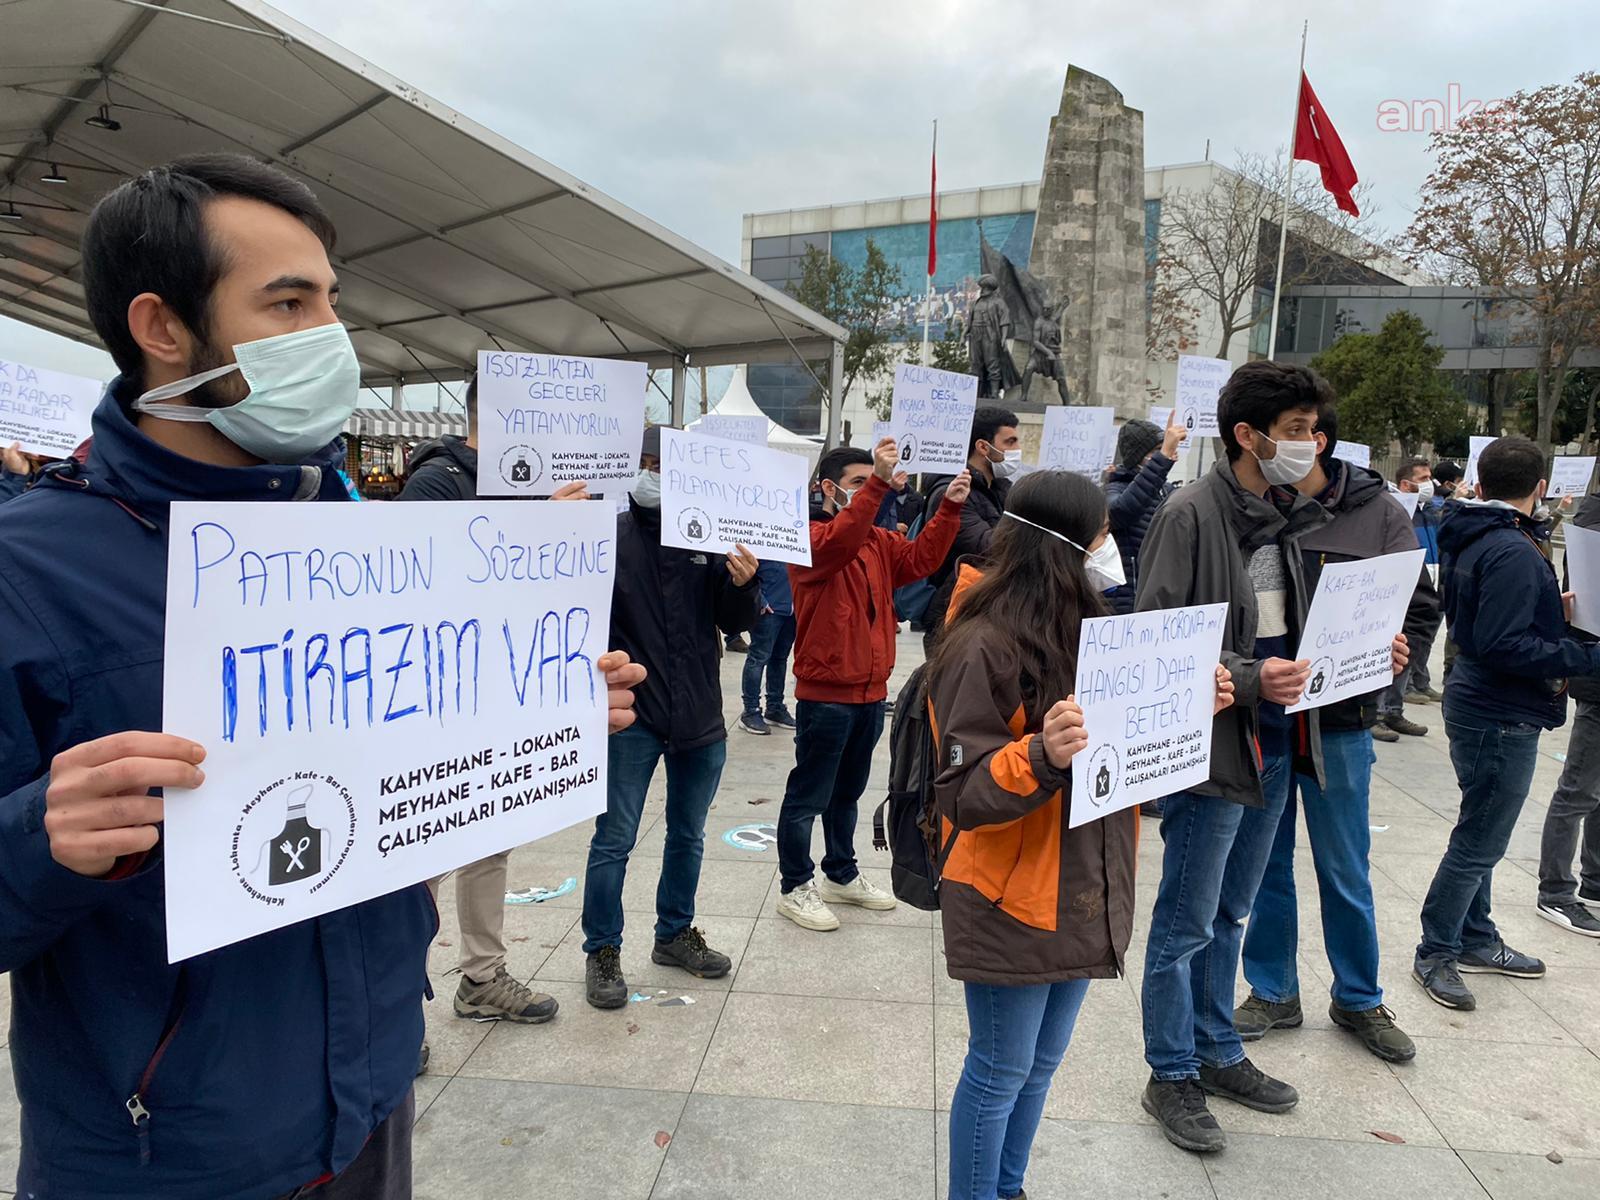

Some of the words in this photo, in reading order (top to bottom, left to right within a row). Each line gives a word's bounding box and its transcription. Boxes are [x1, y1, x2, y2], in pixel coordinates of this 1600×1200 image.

[16, 364, 39, 384] DA
[17, 385, 76, 412] KADAR
[529, 382, 607, 402] GECELERİ
[496, 408, 621, 437] YATAMIYORUM
[552, 452, 598, 460] KAHVEHANE
[604, 452, 630, 460] LOKANTA
[617, 461, 629, 469] BAR
[669, 438, 751, 473] NEFES
[552, 473, 598, 482] ÇALIŞANLARI
[599, 471, 635, 480] DAYANIŞMASI
[718, 517, 763, 529] KAHVEHANE
[770, 524, 798, 536] LOKANTA
[718, 526, 754, 537] MEYHANE
[761, 531, 779, 540] KAFE
[785, 535, 798, 543] BAR
[718, 535, 764, 547] ÇALIŞANLARI
[766, 541, 807, 554] DAYANIŞMASI
[192, 522, 433, 608] PATRONUN
[467, 516, 610, 584] SÖZLERİNE
[1083, 619, 1134, 657] AÇLIK
[1162, 610, 1206, 642] KORONA
[502, 607, 596, 708] VAR
[1080, 659, 1146, 706] HANGİSİ
[1154, 655, 1196, 692] DAHA
[1125, 688, 1193, 739] BETER?
[1125, 756, 1161, 772] MEYHANE
[1167, 748, 1184, 761] KAFE
[1190, 743, 1201, 754] BAR
[1126, 738, 1171, 758] KAHVEHANE
[1177, 729, 1203, 745] LOKANTA
[379, 748, 493, 796] KAHVEHANE
[513, 725, 581, 758] LOKANTA
[1124, 769, 1170, 789] ÇALIŞANLARI
[1170, 753, 1208, 774] DAYANIŞMASI
[379, 782, 470, 825] MEYHANE
[490, 764, 532, 790] KAFE
[550, 750, 578, 772] BAR
[230, 824, 242, 871] Lokanta
[242, 778, 284, 815] Meyhane
[294, 770, 318, 780] Kafe
[325, 775, 341, 789] Bar
[377, 800, 495, 857] ÇALIŞANLARI
[502, 766, 598, 812] DAYANIŞMASI
